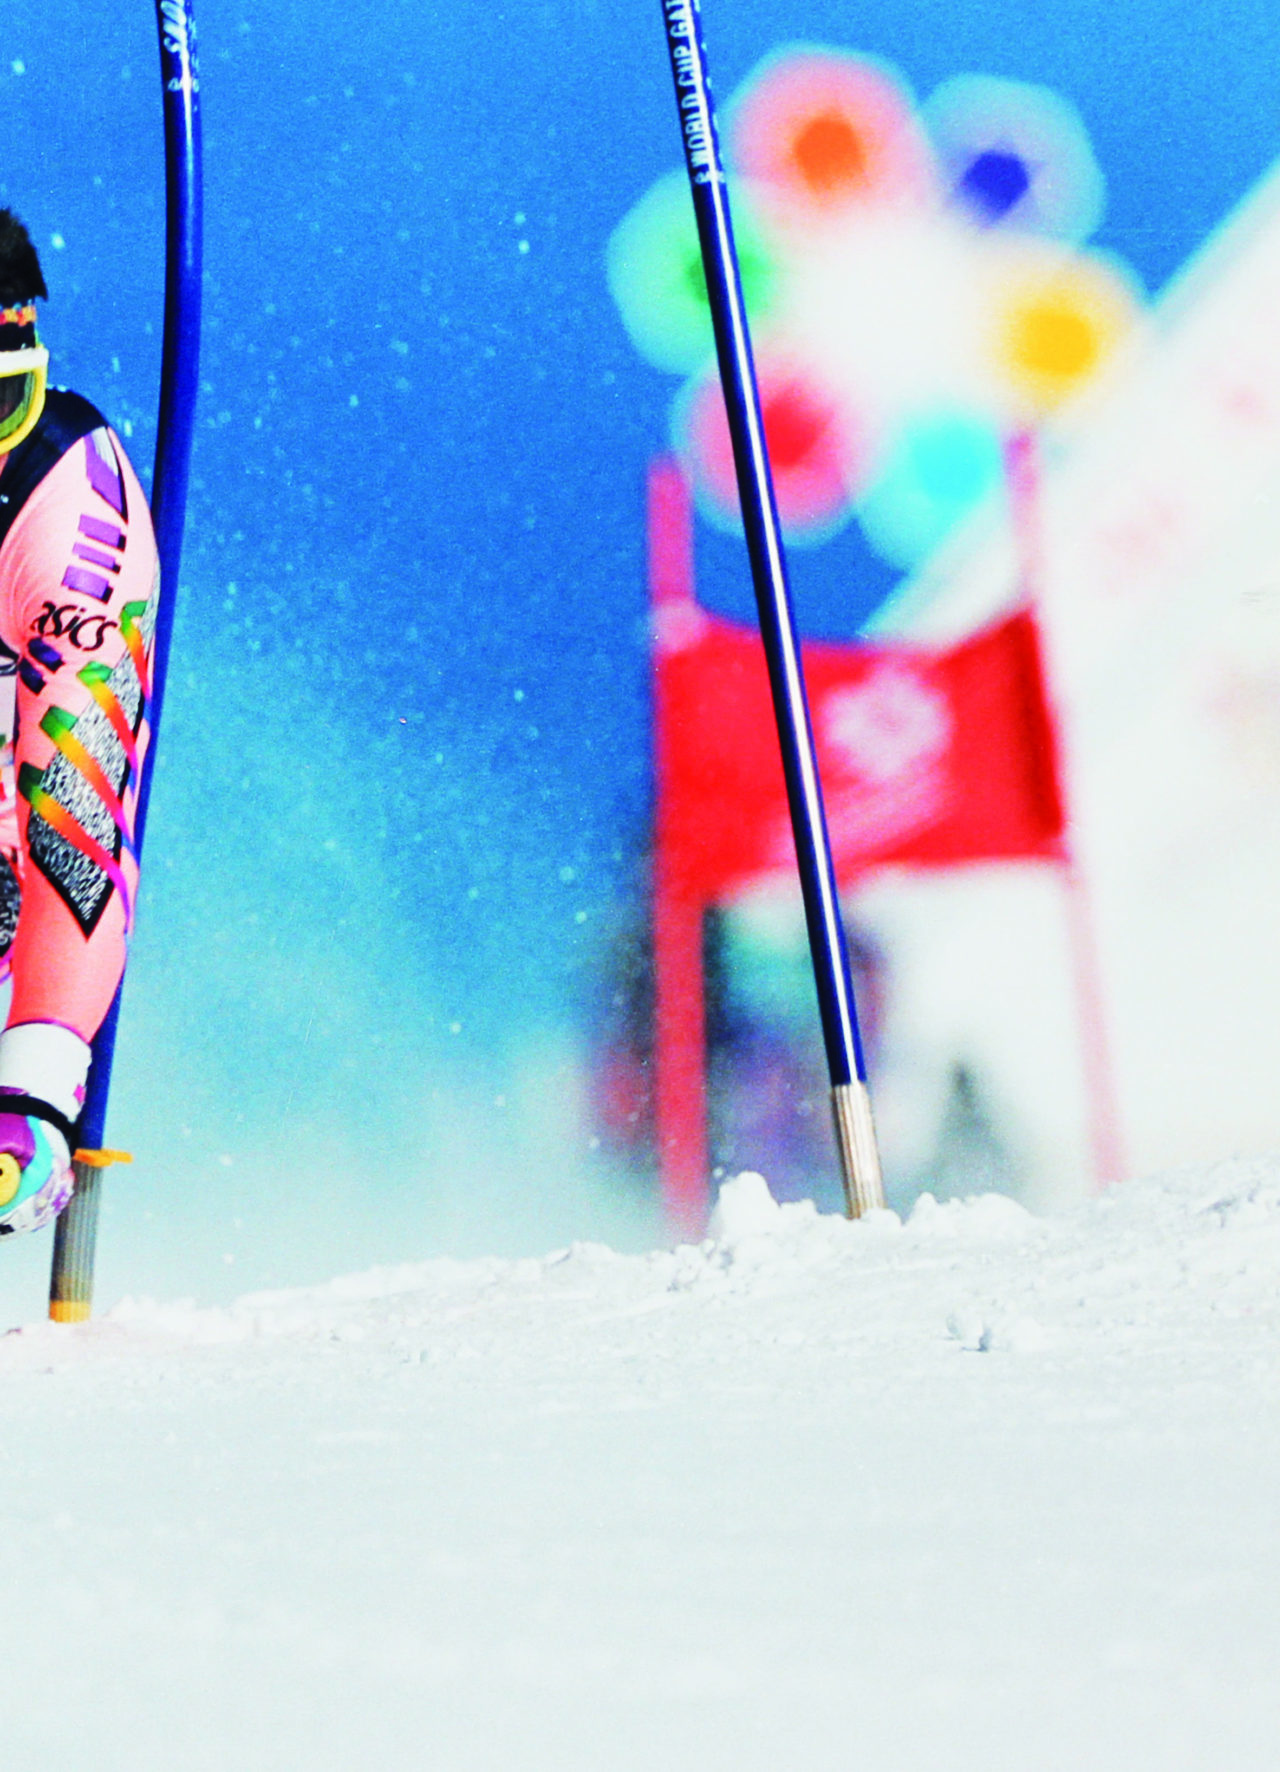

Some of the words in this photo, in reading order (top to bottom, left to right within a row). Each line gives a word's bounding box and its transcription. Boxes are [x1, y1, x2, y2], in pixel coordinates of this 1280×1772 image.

[672, 45, 697, 88] CUP
[681, 93, 710, 169] WORLD
[29, 600, 119, 652] asics
